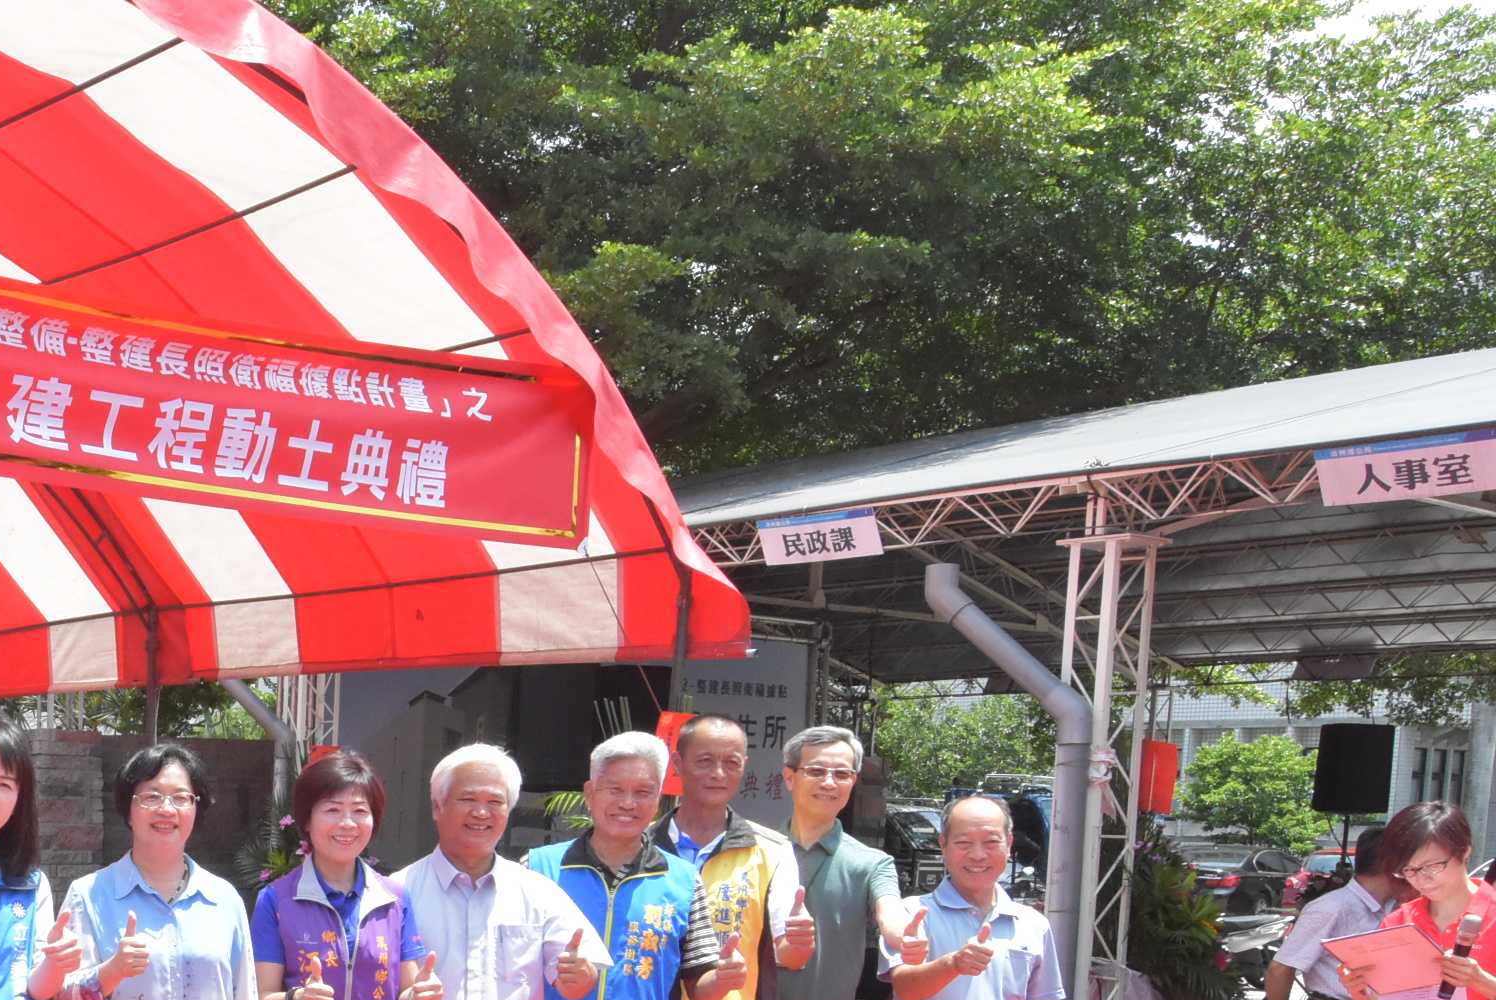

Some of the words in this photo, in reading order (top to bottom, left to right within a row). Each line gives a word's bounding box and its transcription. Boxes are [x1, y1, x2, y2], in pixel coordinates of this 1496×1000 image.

[1356, 453, 1474, 495] 人事室
[781, 526, 857, 557] 民政課
[321, 930, 339, 968] 鄉長
